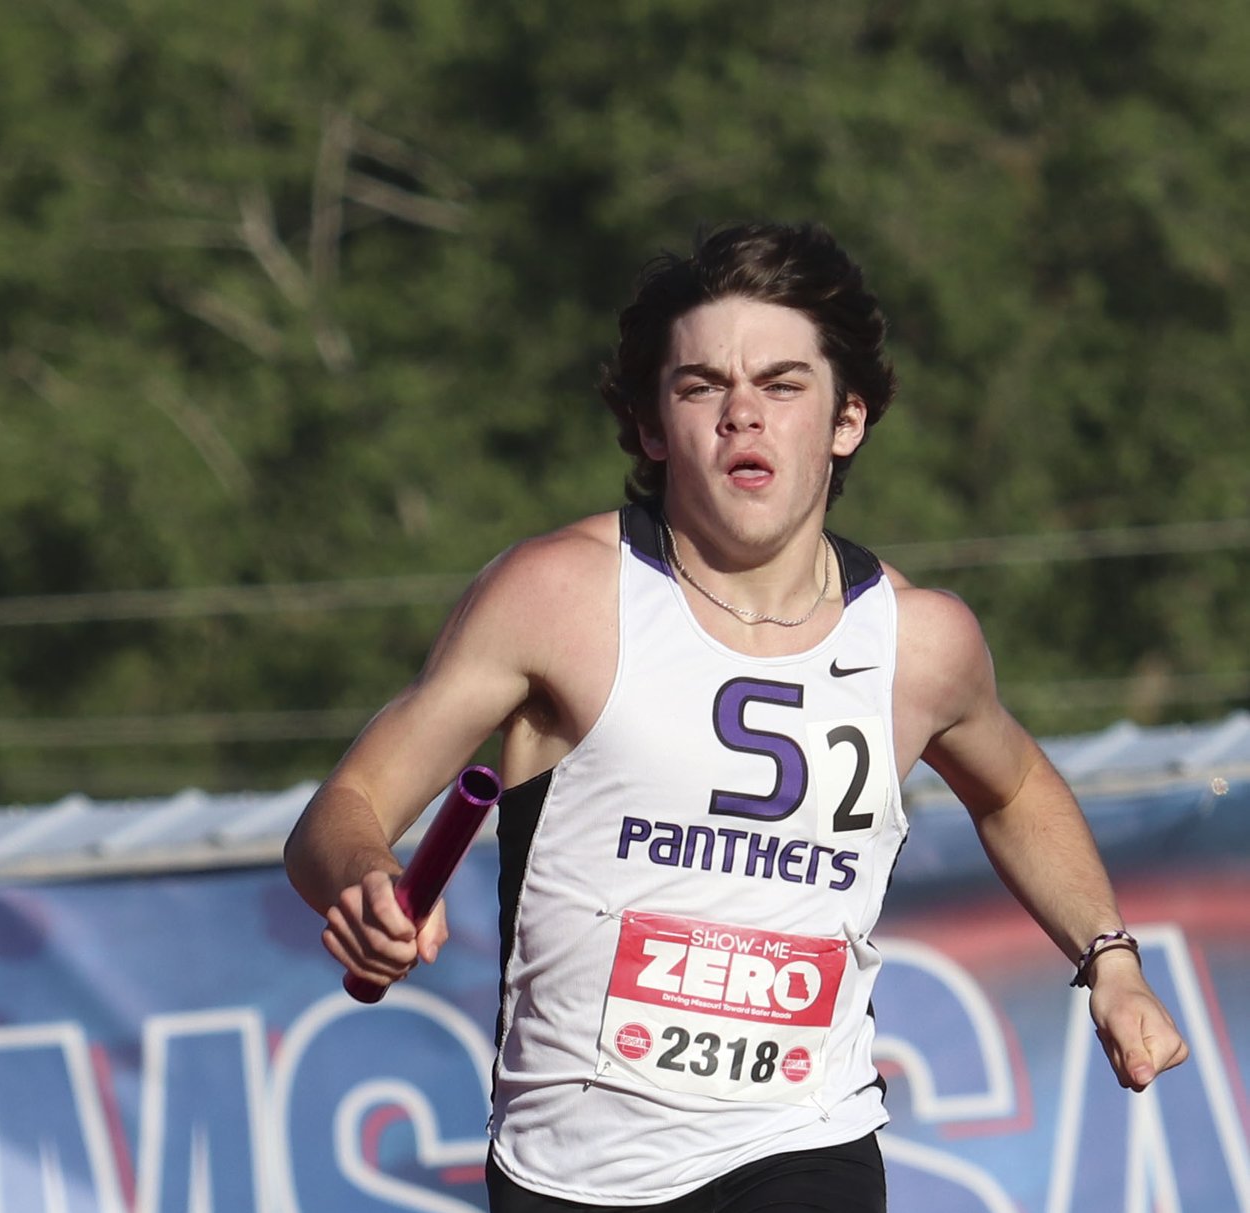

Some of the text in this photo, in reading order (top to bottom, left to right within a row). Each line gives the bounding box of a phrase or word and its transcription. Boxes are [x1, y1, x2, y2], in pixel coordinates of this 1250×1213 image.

[708, 676, 809, 822] S
[826, 724, 875, 833] 2
[636, 938, 822, 1012] ZERO
[690, 929, 791, 960] SHOW-ME
[662, 992, 690, 1006] Driving
[690, 998, 722, 1010] Missouri
[722, 1003, 751, 1014] Toward
[750, 1007, 771, 1017] Safer
[656, 1025, 780, 1083] 2318
